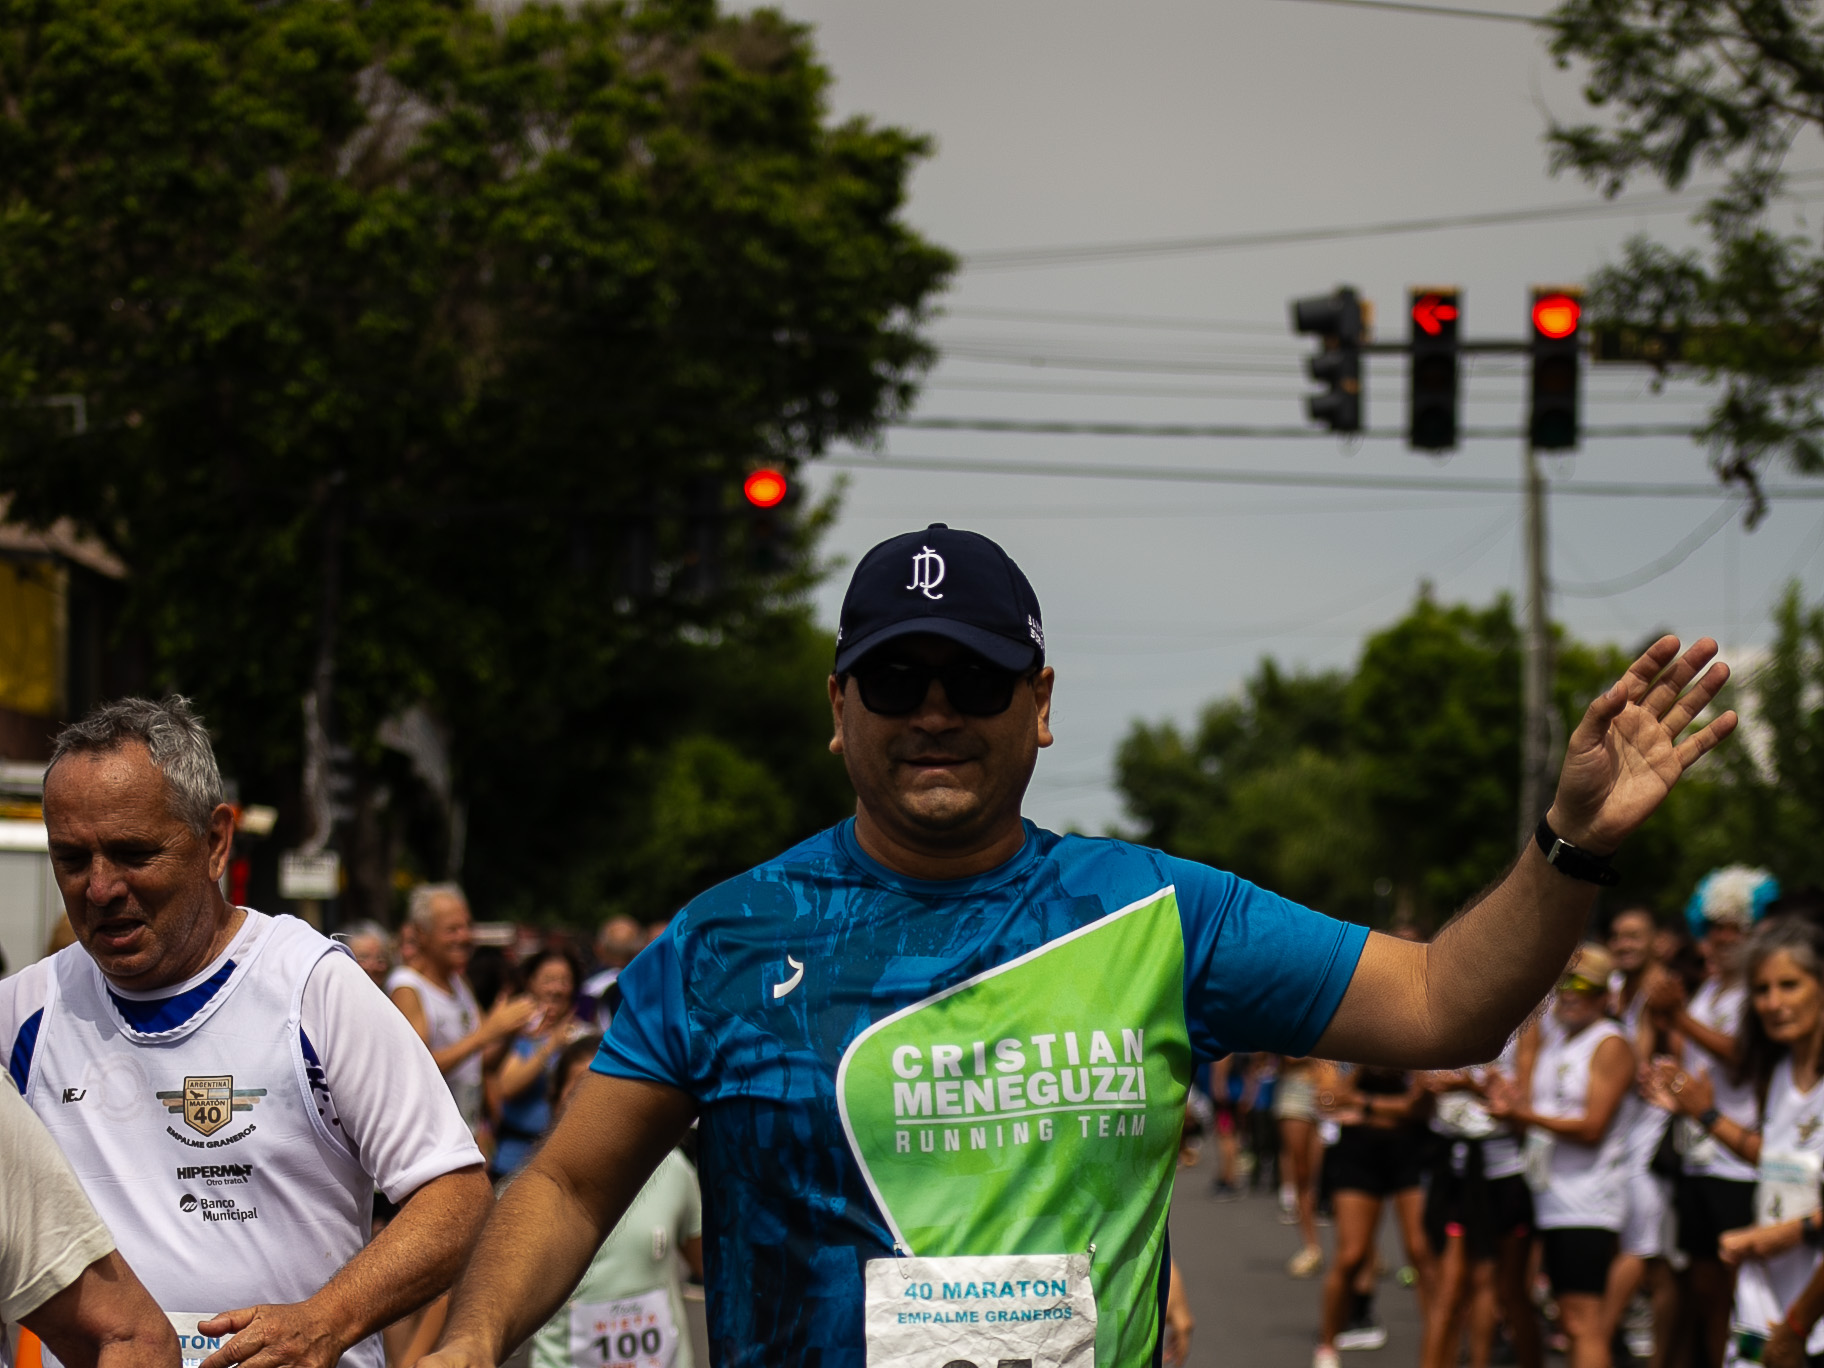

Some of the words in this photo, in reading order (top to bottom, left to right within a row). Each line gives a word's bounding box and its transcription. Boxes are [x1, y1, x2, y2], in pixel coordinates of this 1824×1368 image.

[892, 1028, 1144, 1080] CRISTIAN
[893, 1066, 1147, 1117] MENEGUZZI
[189, 1099, 226, 1107] MARATÓN
[193, 1106, 222, 1124] 40
[166, 1125, 205, 1149] EMPALME
[206, 1123, 257, 1149] GRANEROS
[896, 1118, 1053, 1153] RUNNING
[1078, 1114, 1146, 1138] TEAM
[206, 1178, 222, 1186] Otro
[200, 1198, 235, 1209] Banco
[202, 1206, 258, 1222] Municipal
[904, 1282, 933, 1300] 40
[942, 1279, 1067, 1300] MARATON
[897, 1311, 979, 1324] EMPALME
[985, 1306, 1072, 1323] GRANEROS
[594, 1328, 661, 1360] 100
